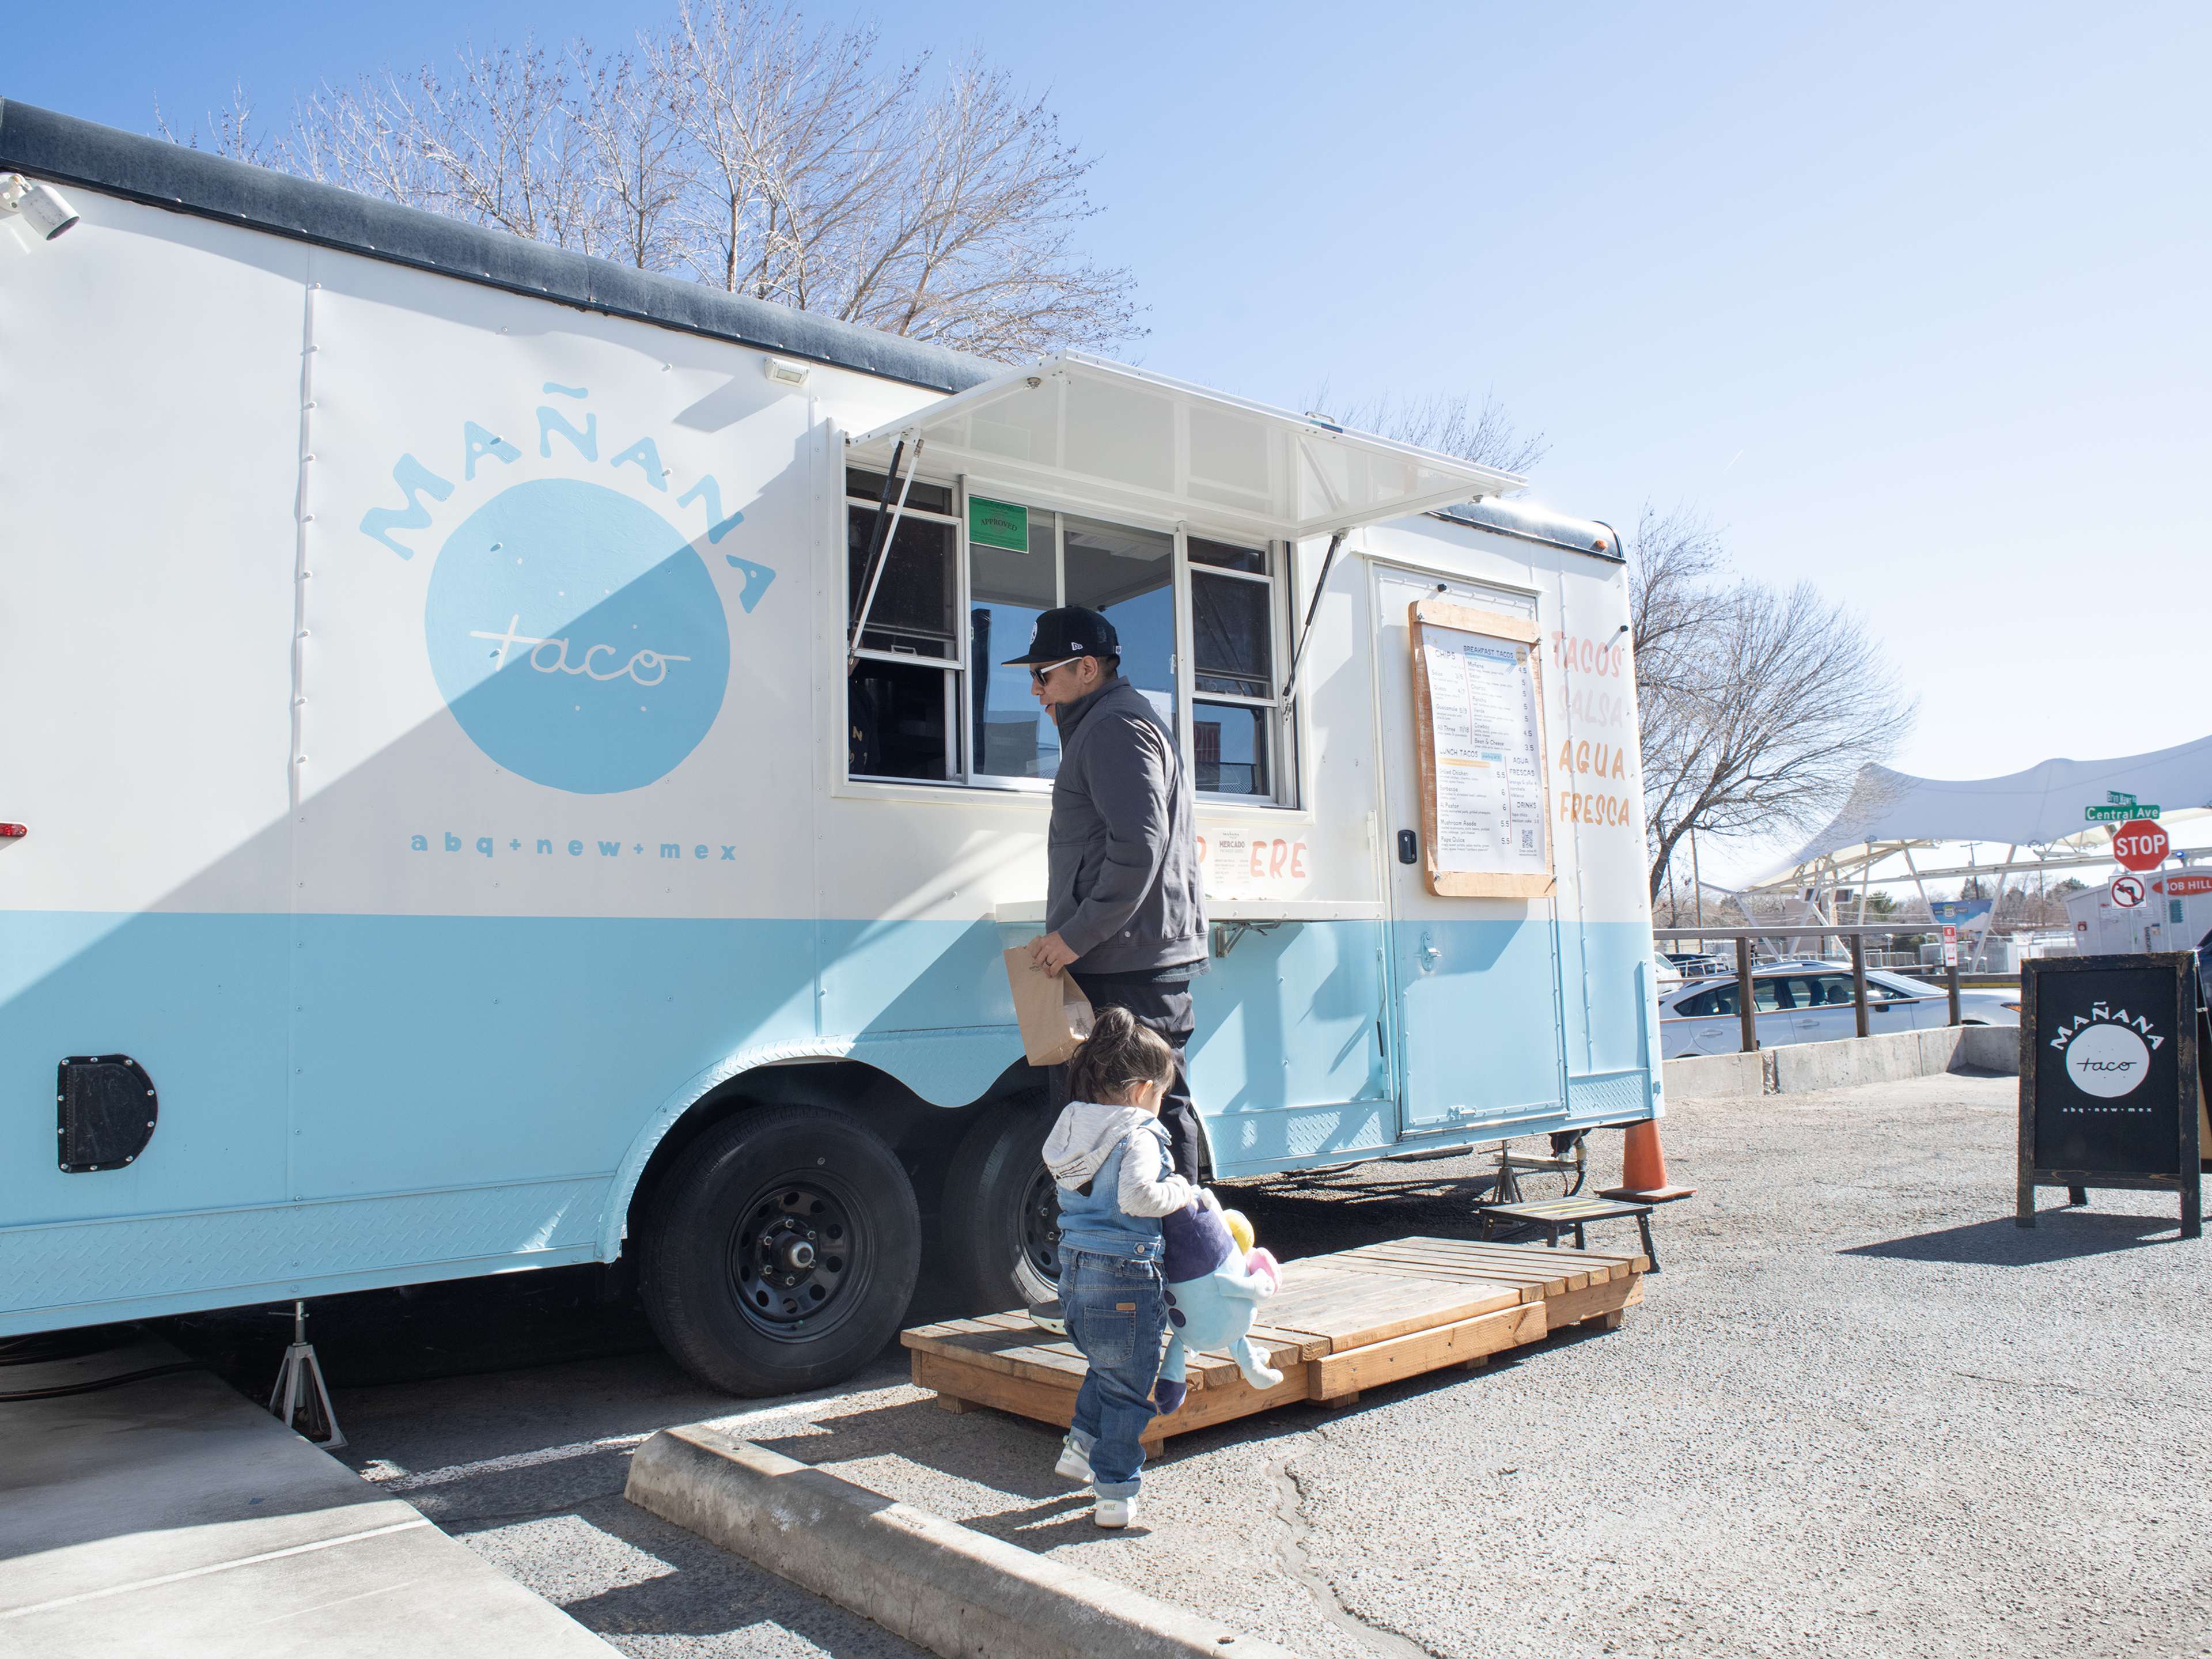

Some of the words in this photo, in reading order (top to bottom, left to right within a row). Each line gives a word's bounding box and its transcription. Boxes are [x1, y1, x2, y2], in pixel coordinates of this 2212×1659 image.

[359, 382, 777, 615] MAÑANA
[980, 518, 1017, 532] APPROVED
[470, 613, 691, 687] taco
[1435, 649, 1456, 660] CHIPS
[1463, 645, 1494, 656] BREAKFAST
[1496, 650, 1514, 658] TACOS
[1552, 631, 1622, 678] TACOS
[1558, 684, 1623, 729] SALSA
[1440, 748, 1458, 756] LUNCH
[1459, 749, 1478, 758] TACOS
[1513, 756, 1529, 765] AGUA
[1559, 740, 1626, 781] AGUA
[1509, 768, 1535, 777] FRESCAS
[1517, 801, 1537, 809] DRINKS
[1559, 791, 1630, 827] FRESCA
[2086, 808, 2133, 820] Central
[2137, 807, 2158, 818] Ave
[1219, 840, 1245, 849] MERCADO
[2116, 834, 2166, 857] STOP
[2188, 880, 2212, 890] HILL
[2050, 1001, 2165, 1051] MAÑANA
[2076, 1057, 2138, 1073] taco
